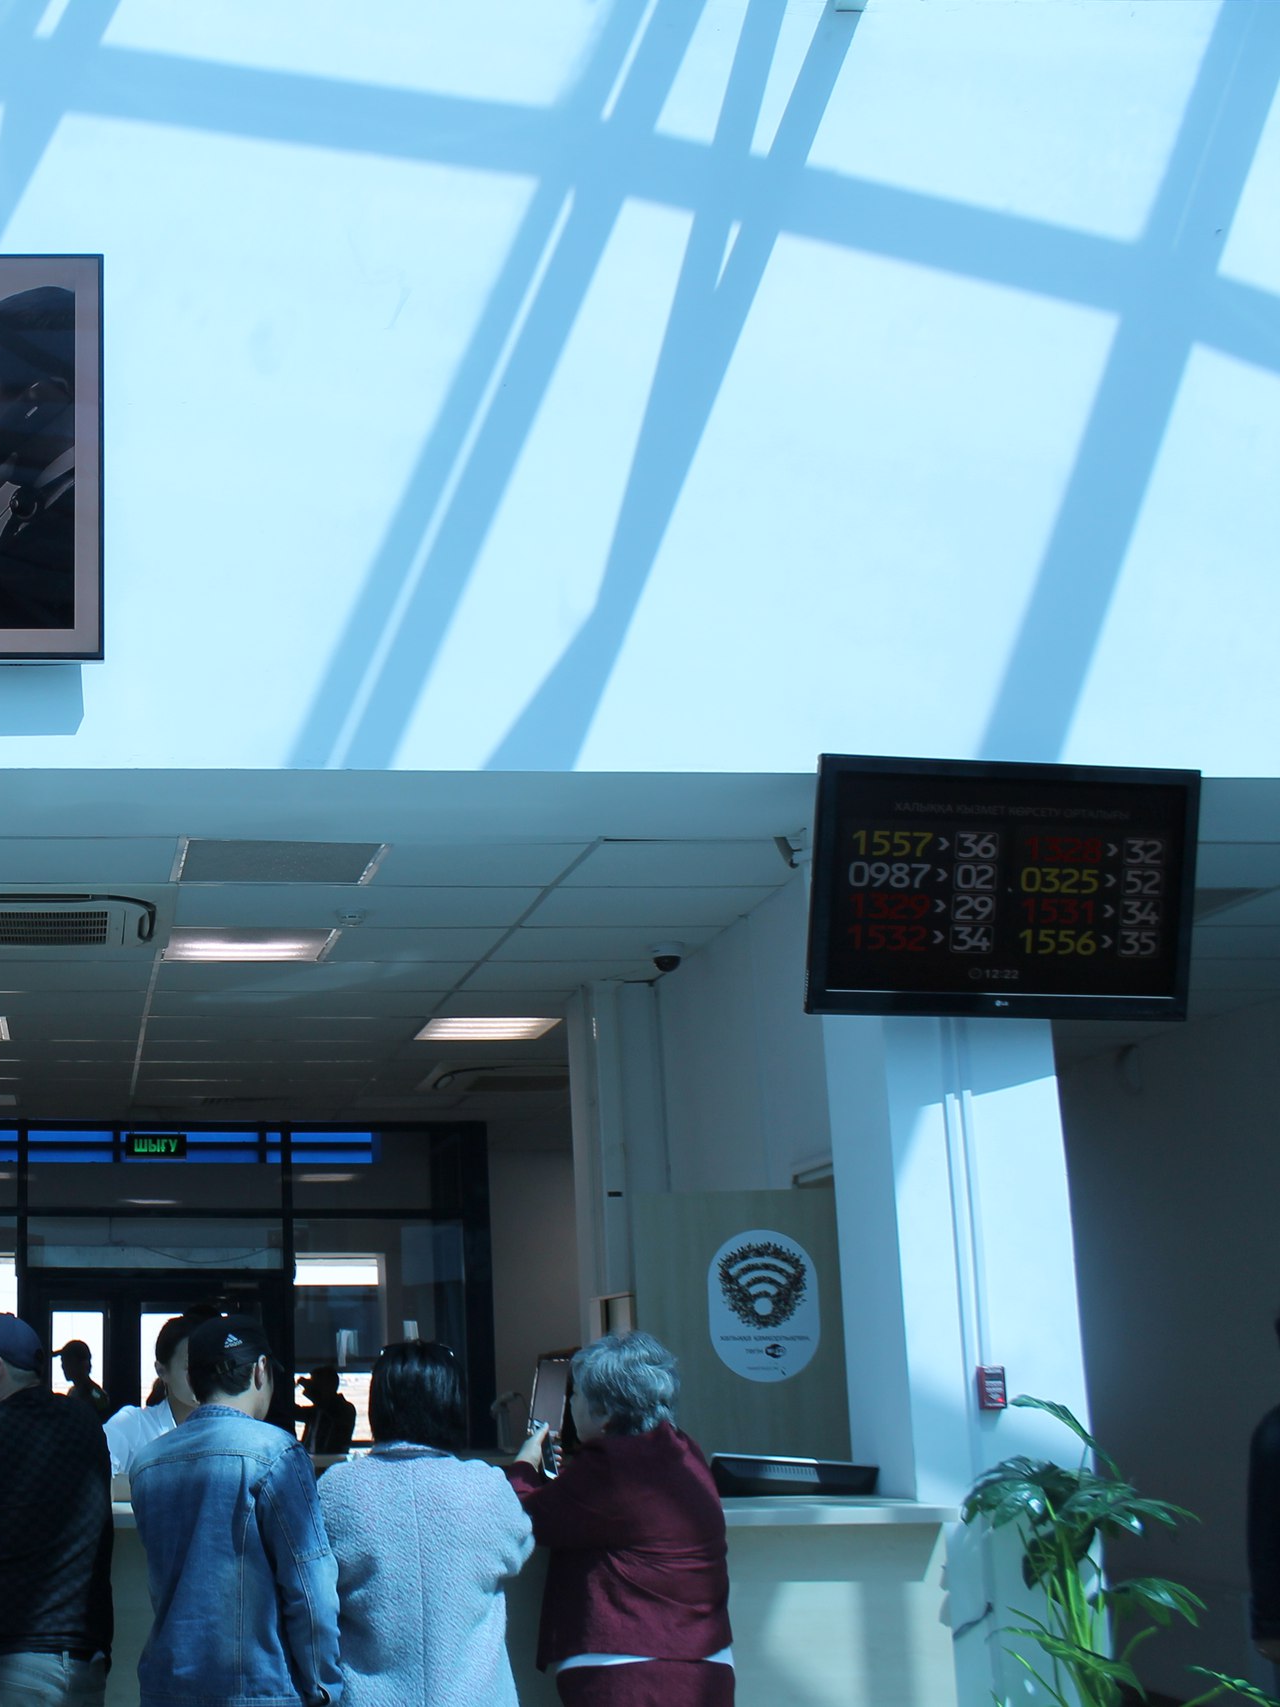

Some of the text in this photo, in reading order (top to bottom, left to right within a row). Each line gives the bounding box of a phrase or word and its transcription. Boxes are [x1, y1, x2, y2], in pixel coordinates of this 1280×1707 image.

[852, 830, 996, 858] 1557 36
[1024, 836, 1163, 865] 1328 32
[848, 861, 994, 889] 0987 02
[1020, 867, 1161, 895] 0325 52
[850, 893, 993, 920] 1329 29
[1022, 898, 1159, 925] 1531 34
[848, 924, 991, 951] 1532 34
[1019, 929, 1157, 956] 1556 35
[984, 968, 1019, 980] 12:22
